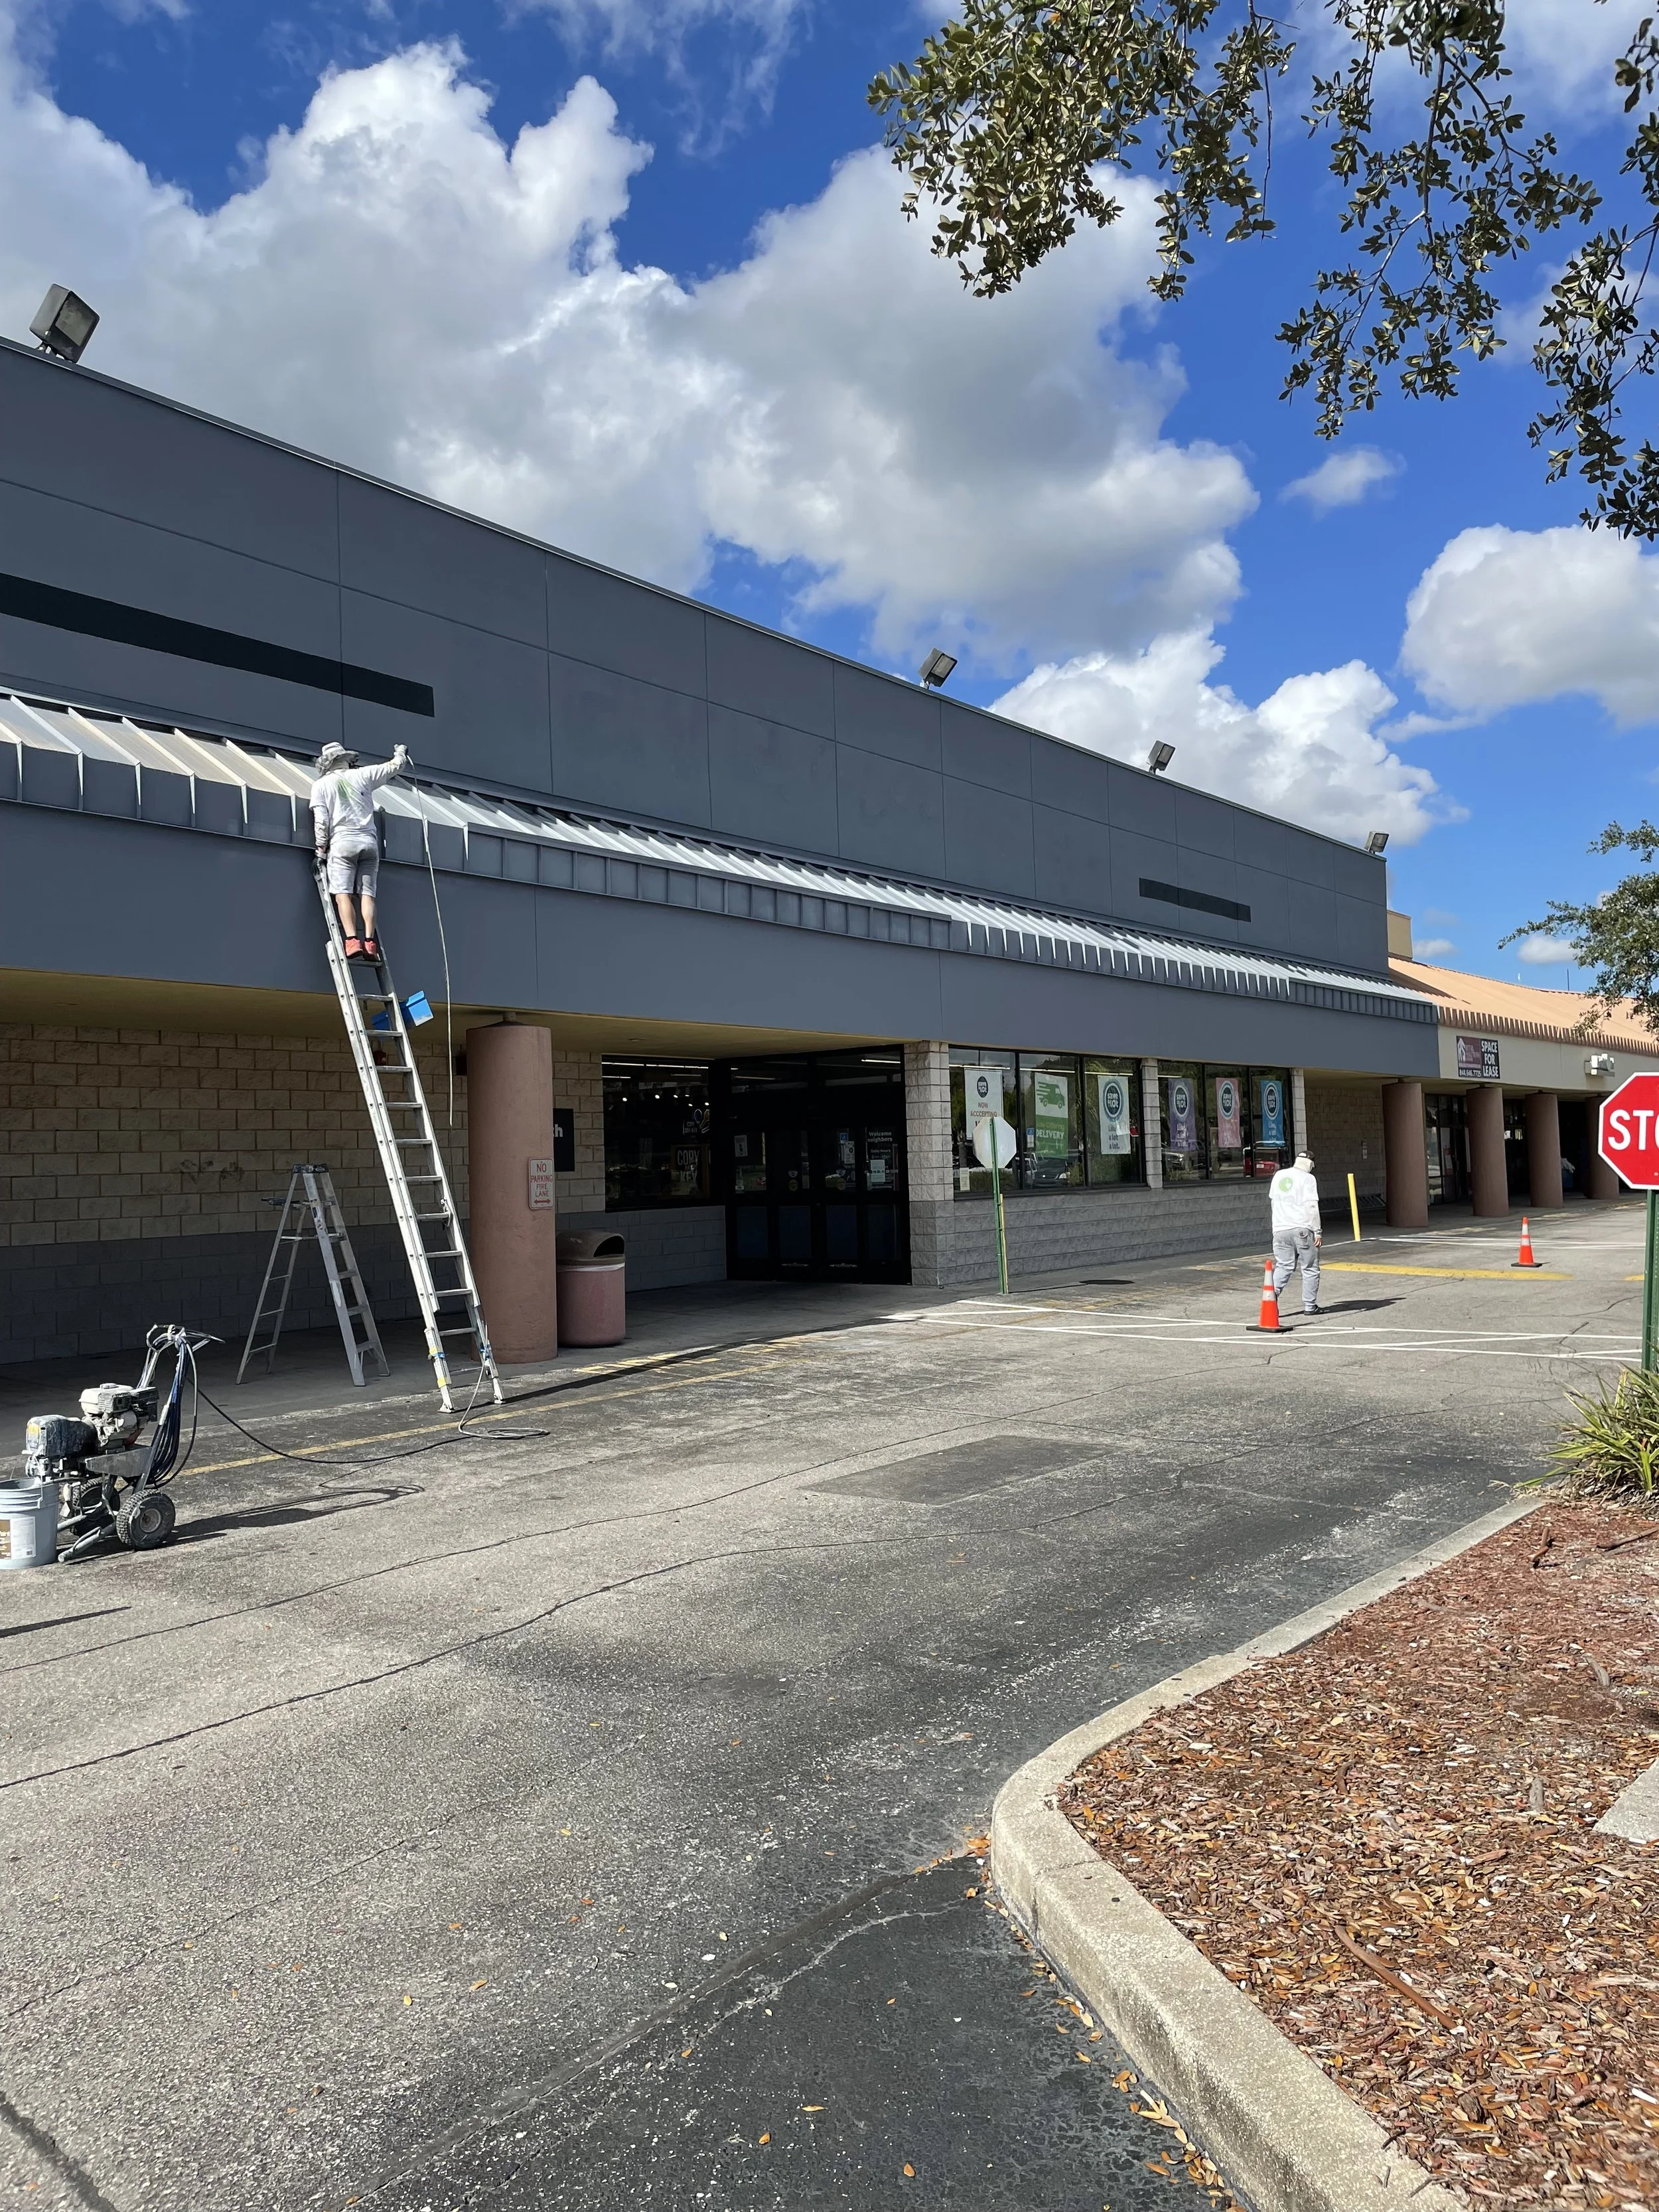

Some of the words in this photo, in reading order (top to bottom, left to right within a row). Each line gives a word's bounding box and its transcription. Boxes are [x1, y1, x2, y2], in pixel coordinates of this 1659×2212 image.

[1481, 1041, 1498, 1053] SPACE
[1484, 1053, 1496, 1065] FOR
[1482, 1065, 1499, 1078] LEASE
[553, 1124, 563, 1138] h
[1036, 1129, 1064, 1140] DELIVERY
[1608, 1110, 1659, 1150] ST
[677, 1149, 700, 1165] COPY
[536, 1163, 547, 1173] NO
[531, 1175, 553, 1183] PARKING
